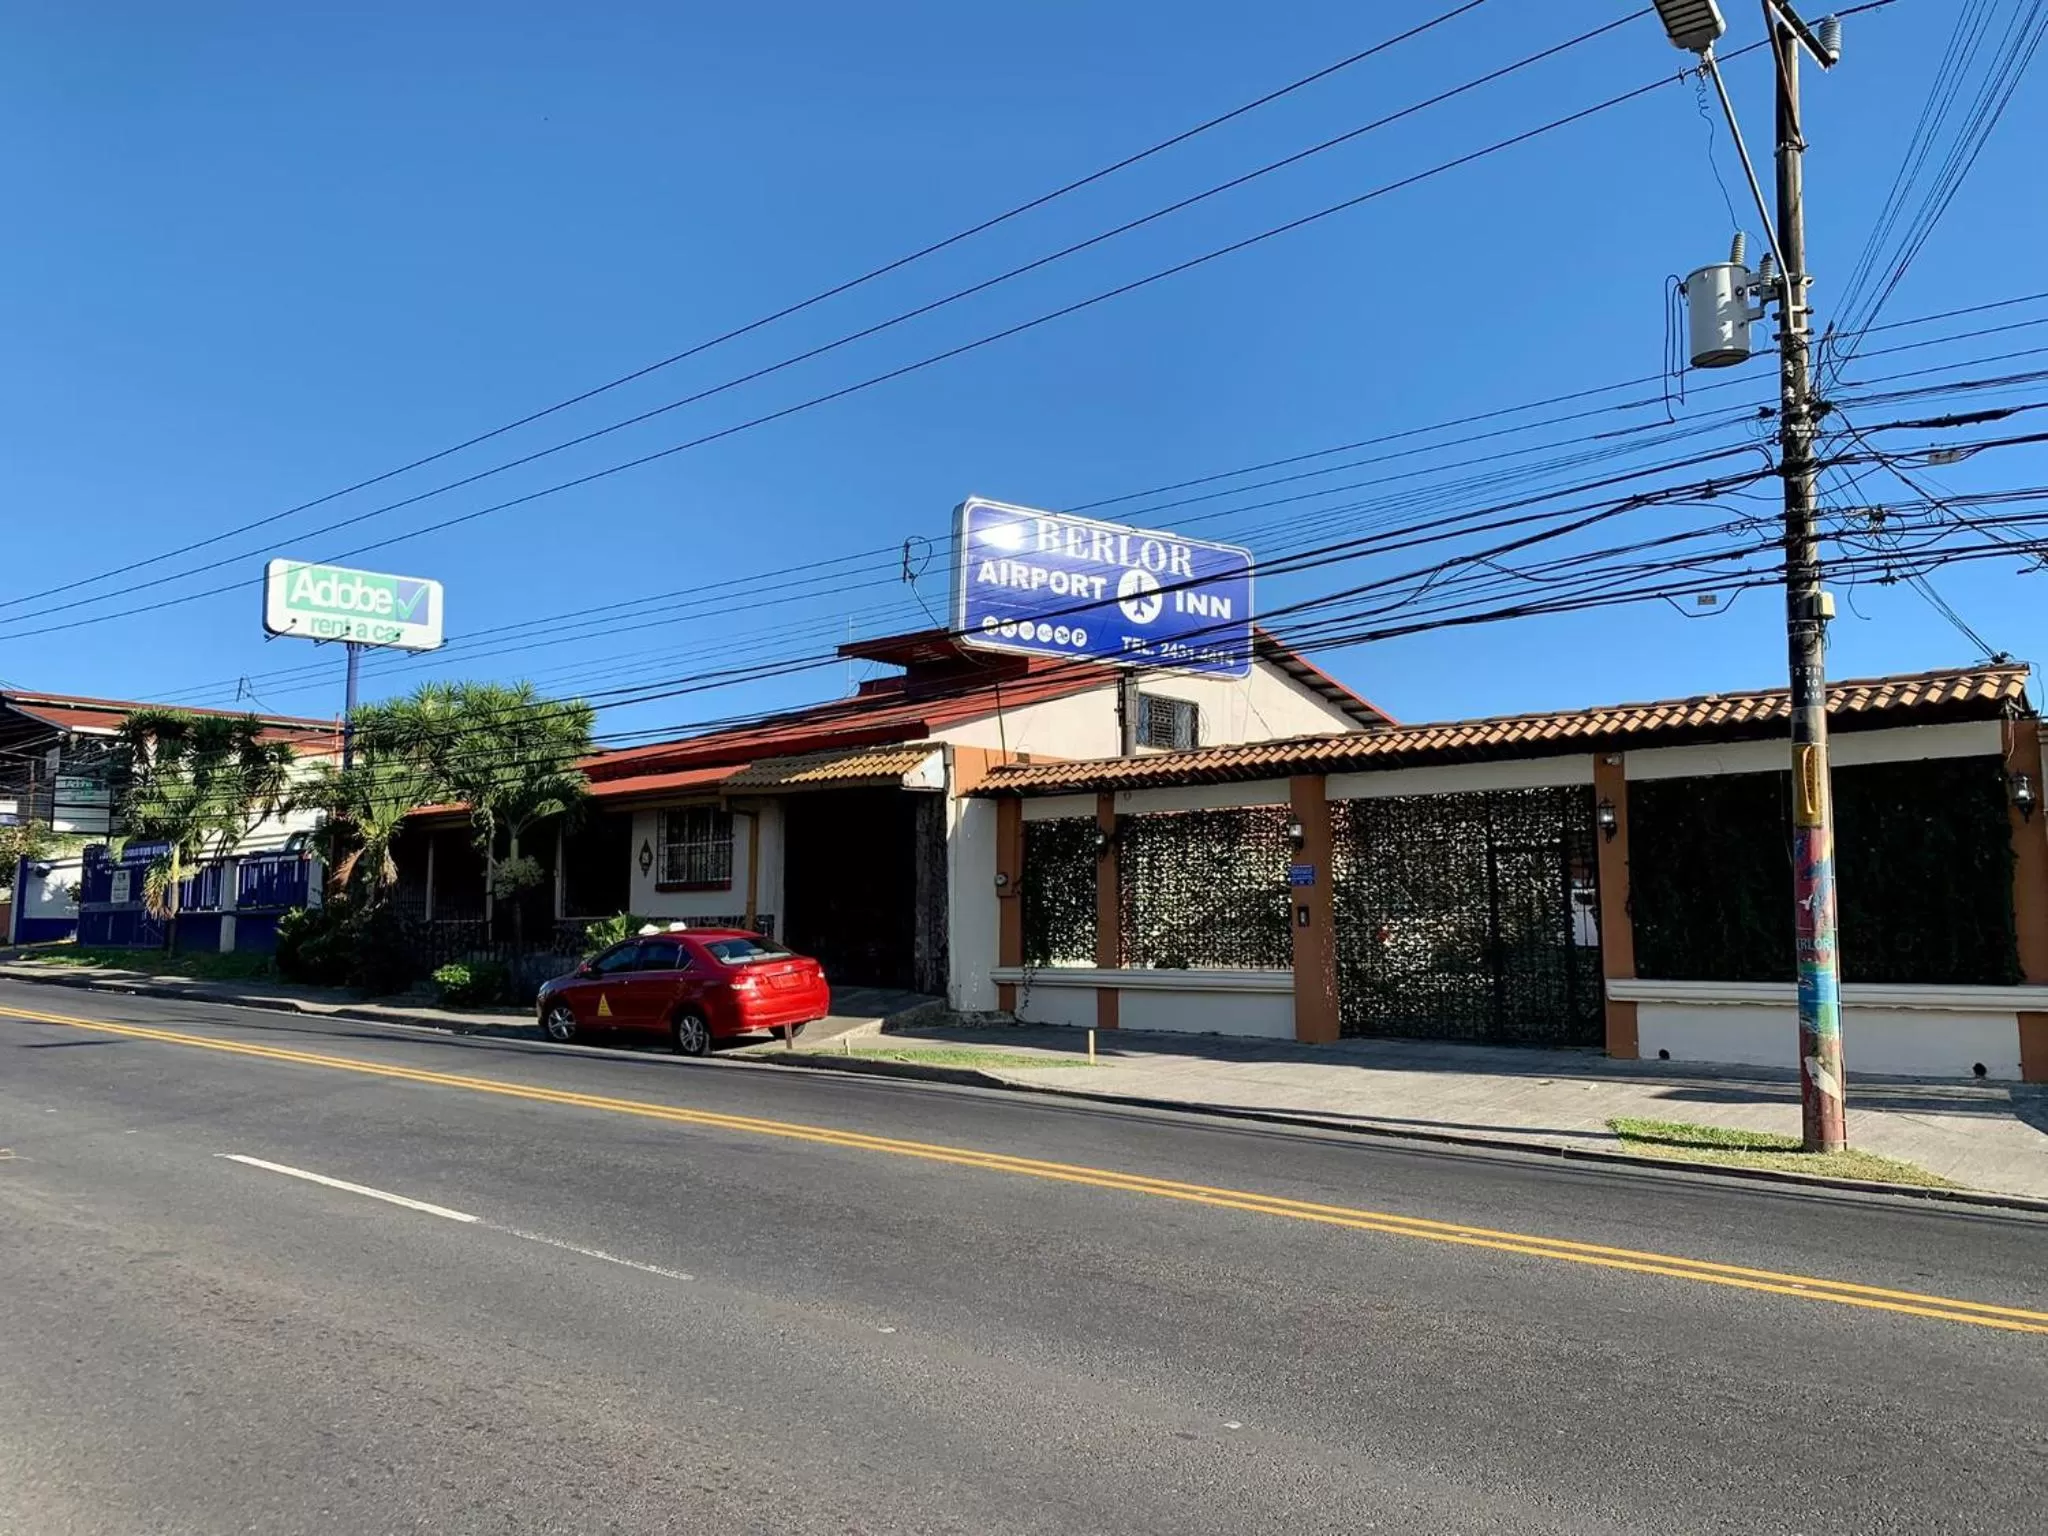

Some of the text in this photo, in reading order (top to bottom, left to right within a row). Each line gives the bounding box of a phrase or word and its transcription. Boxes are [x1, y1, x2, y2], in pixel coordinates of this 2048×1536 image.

[1035, 518, 1193, 577] BERLOR
[289, 568, 394, 615] Adobe
[976, 560, 1232, 620] AIRPORT INN
[310, 616, 405, 642] rent a car
[1121, 635, 1155, 655] TEL.
